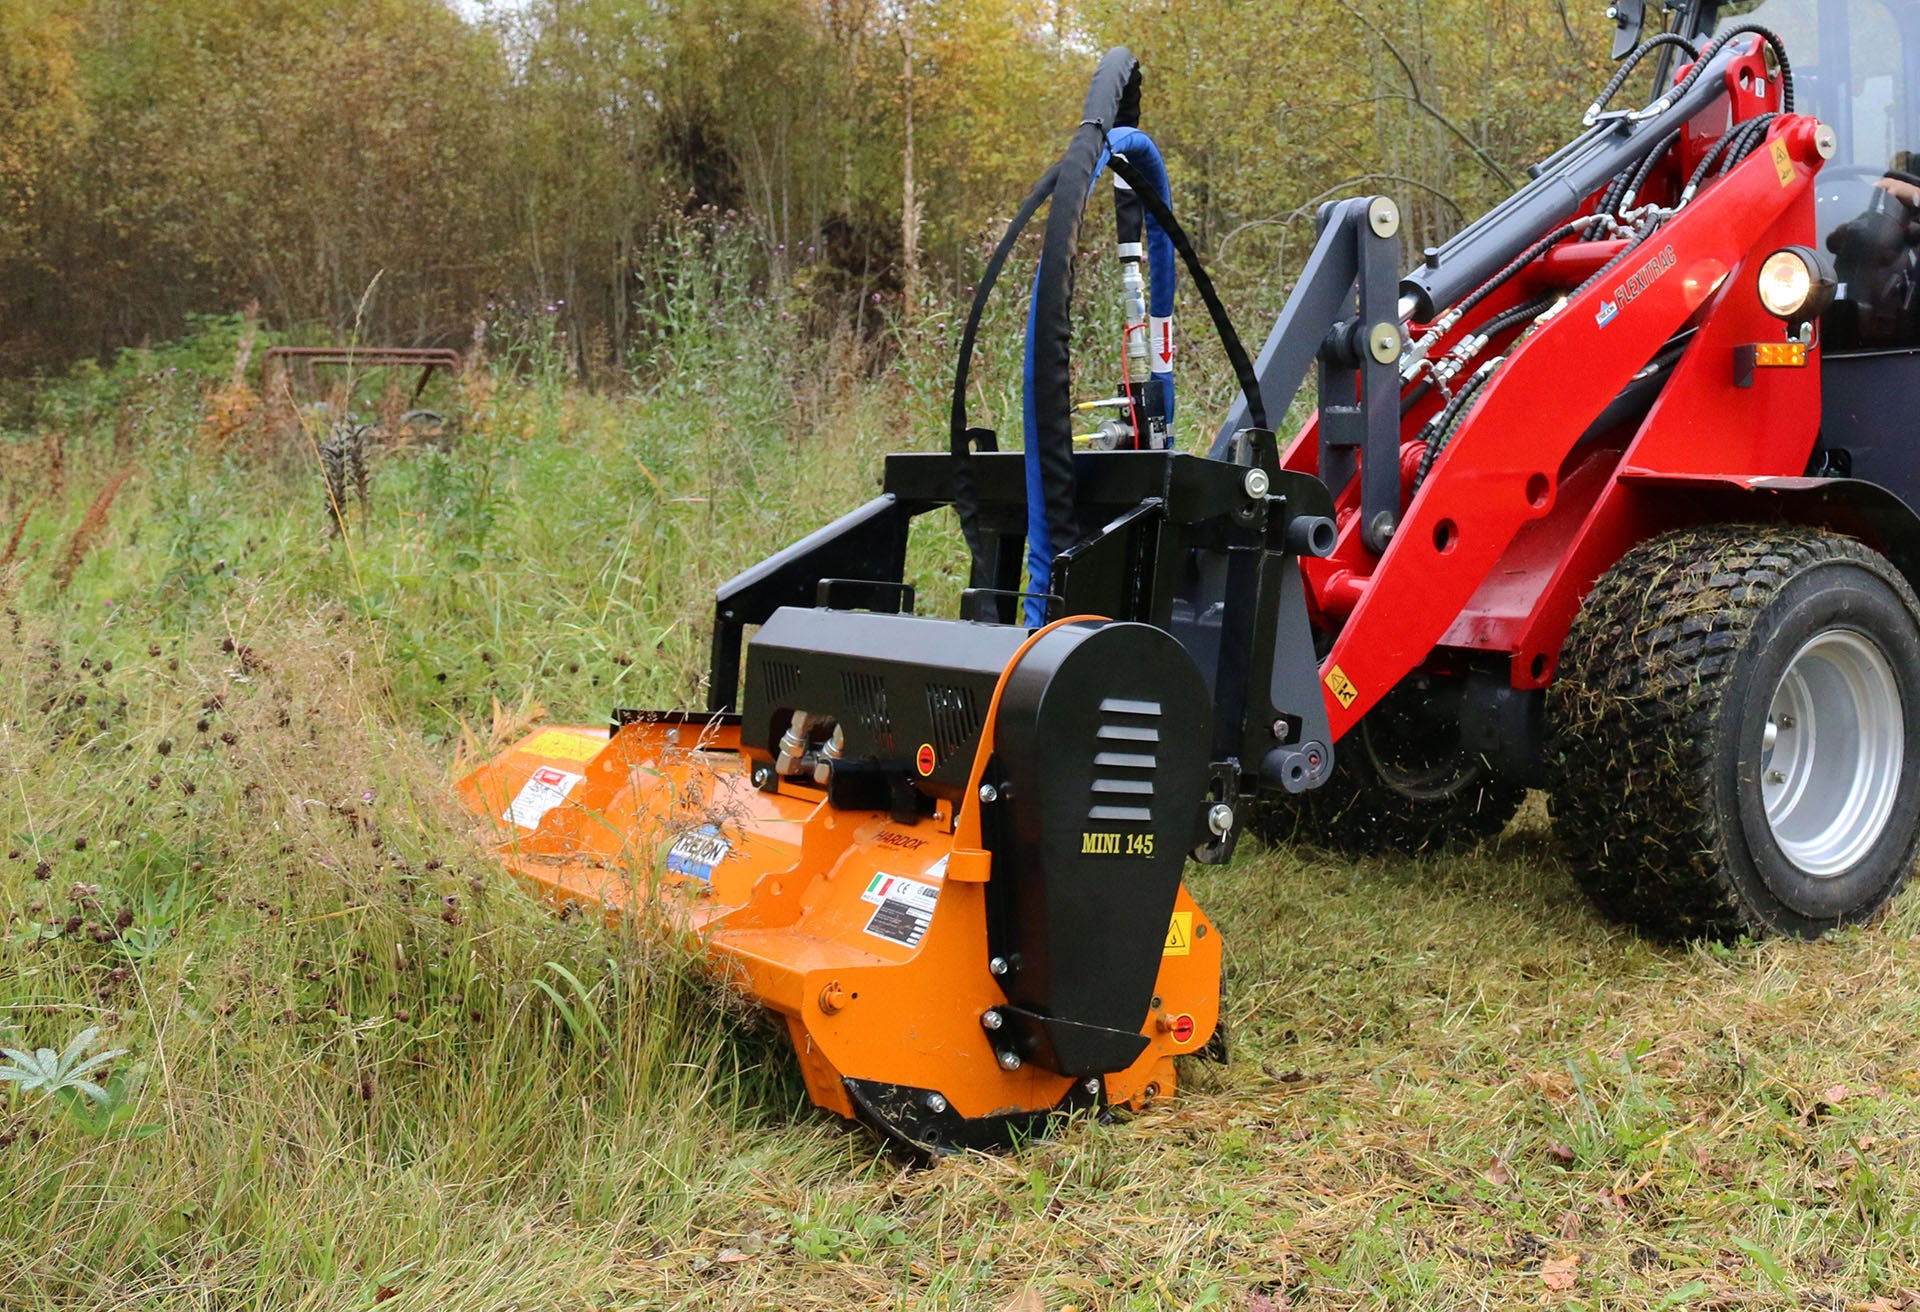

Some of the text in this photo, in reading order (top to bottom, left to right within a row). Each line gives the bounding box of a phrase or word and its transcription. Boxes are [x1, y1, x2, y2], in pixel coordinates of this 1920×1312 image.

[1614, 245, 1677, 310] FLEXITRAC
[873, 830, 925, 850] HARDOX
[1081, 832, 1154, 855] MINI 145
